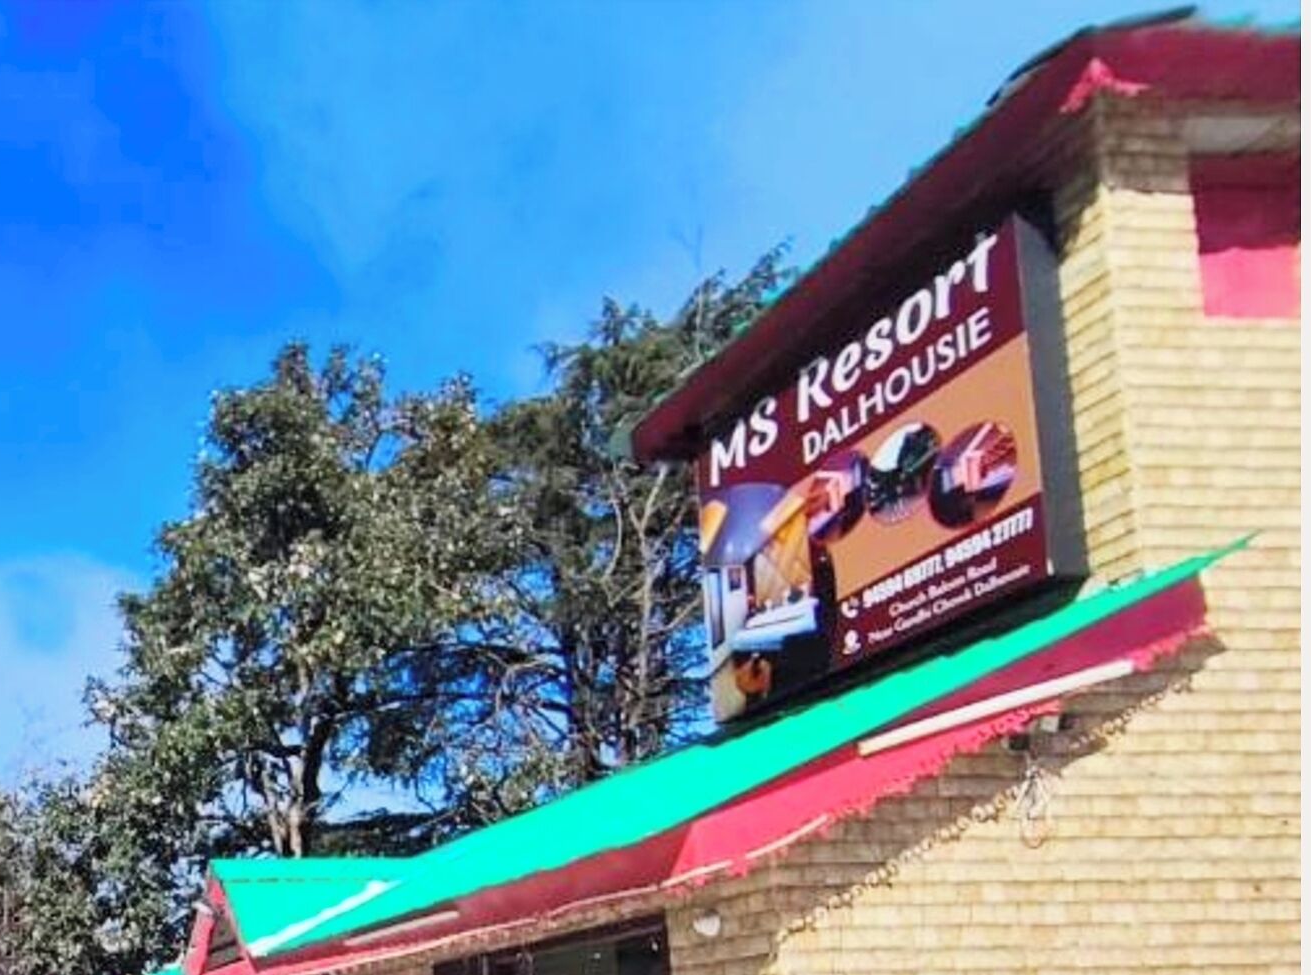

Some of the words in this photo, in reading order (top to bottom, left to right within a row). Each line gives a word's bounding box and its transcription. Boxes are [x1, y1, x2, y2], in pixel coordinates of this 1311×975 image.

[710, 396, 778, 487] MS
[797, 233, 997, 423] Resort
[802, 308, 993, 465] DALHOUSIE
[967, 556, 998, 580] Road
[973, 564, 1030, 597] Dalhousie
